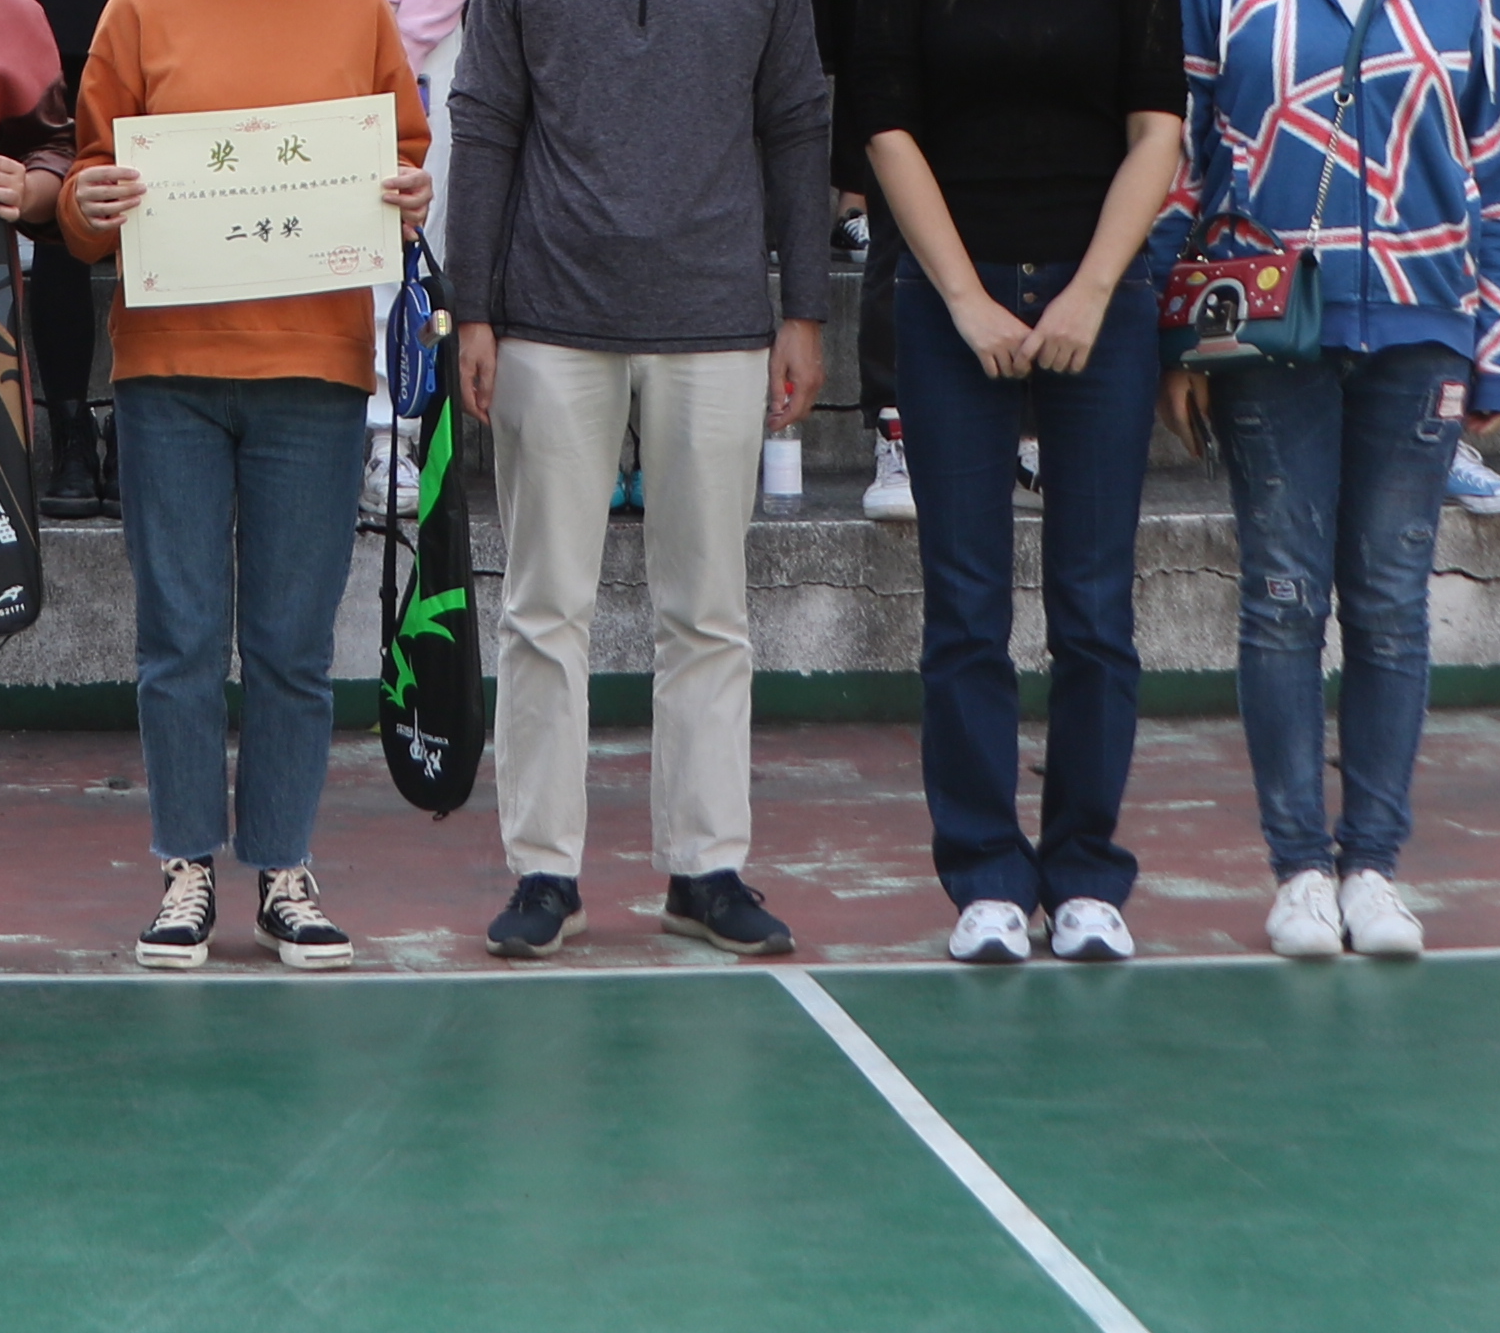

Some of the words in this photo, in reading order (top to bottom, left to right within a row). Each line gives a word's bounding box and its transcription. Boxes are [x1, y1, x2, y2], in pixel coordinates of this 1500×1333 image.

[207, 134, 312, 172] 奖状
[225, 216, 303, 243] 二等奖
